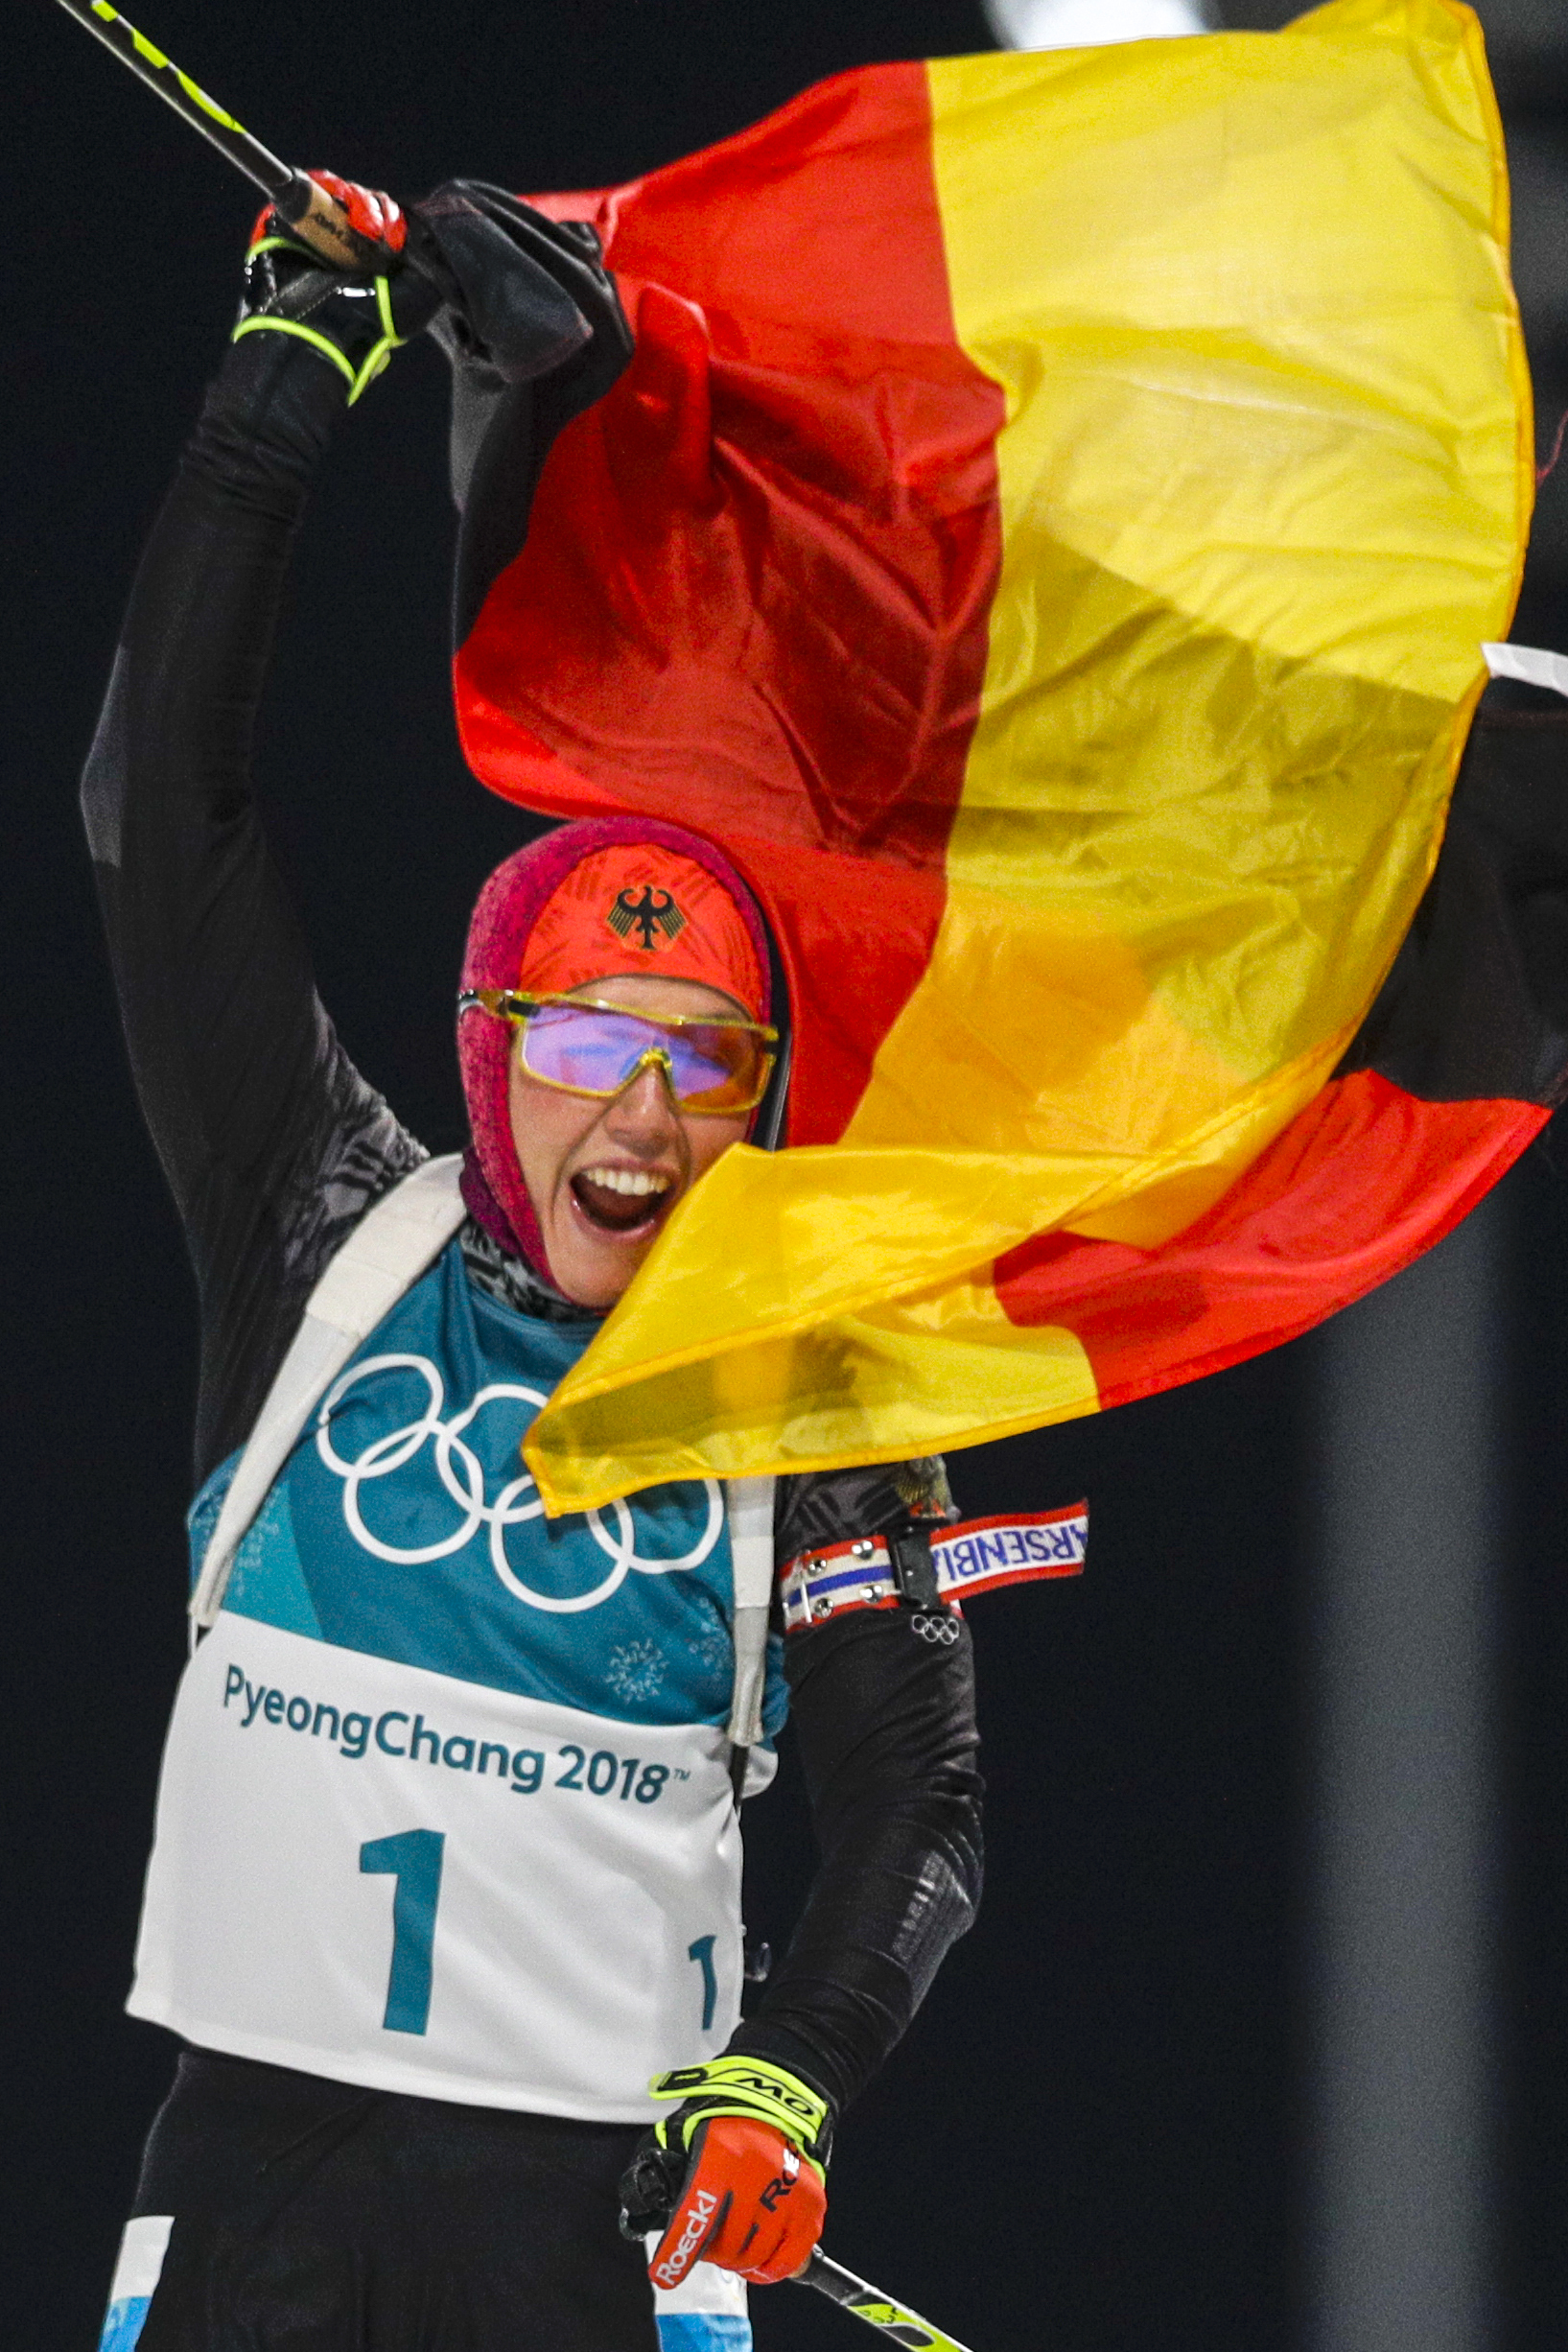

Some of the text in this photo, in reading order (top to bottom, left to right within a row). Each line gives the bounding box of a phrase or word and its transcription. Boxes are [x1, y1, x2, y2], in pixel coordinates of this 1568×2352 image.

[223, 1663, 546, 1794] PyeongChang
[555, 1745, 669, 1803] 2018
[359, 1828, 446, 2036] 1
[688, 1935, 717, 2031] 1
